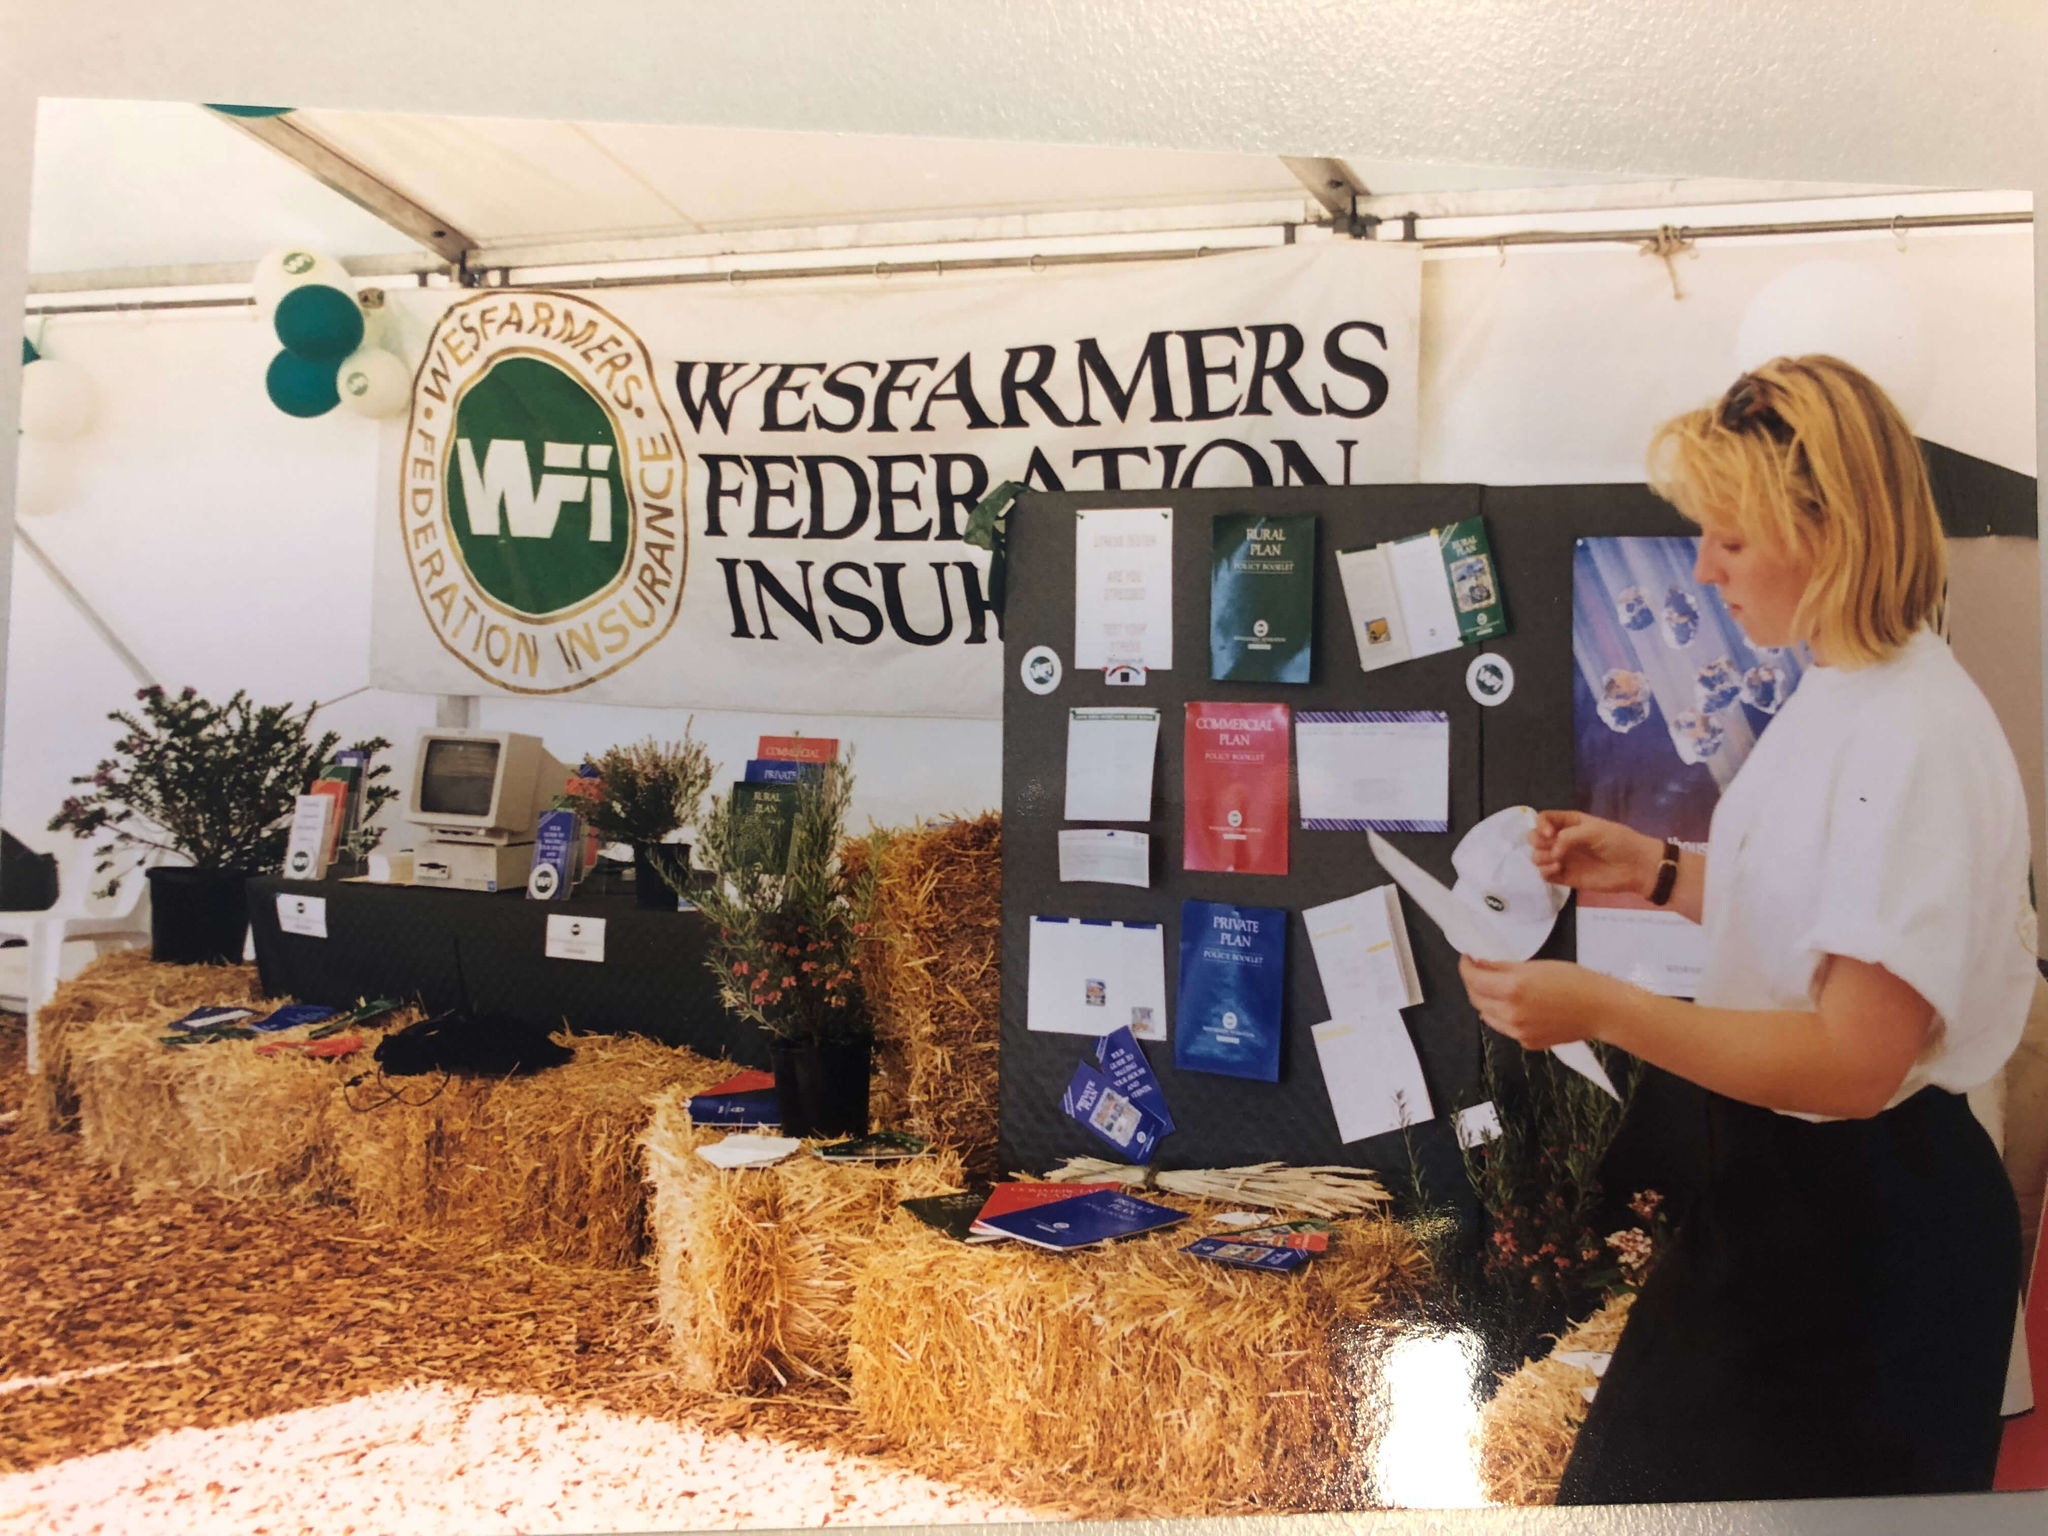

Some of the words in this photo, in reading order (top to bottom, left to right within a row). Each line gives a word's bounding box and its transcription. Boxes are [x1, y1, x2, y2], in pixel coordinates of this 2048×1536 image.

[424, 301, 645, 410] WESFARMERS
[674, 321, 1389, 435] WESFARMERS
[1246, 528, 1286, 541] RURAL
[411, 429, 540, 677] FEDERATION
[555, 431, 677, 672] INSURANCE
[1250, 543, 1281, 556] PLAN
[1196, 717, 1275, 732] COMMERCIAL
[1218, 733, 1251, 746] PLAN
[1212, 915, 1260, 934] PRIVATE
[1220, 932, 1251, 948] PLAN
[1203, 949, 1230, 961] POLICY
